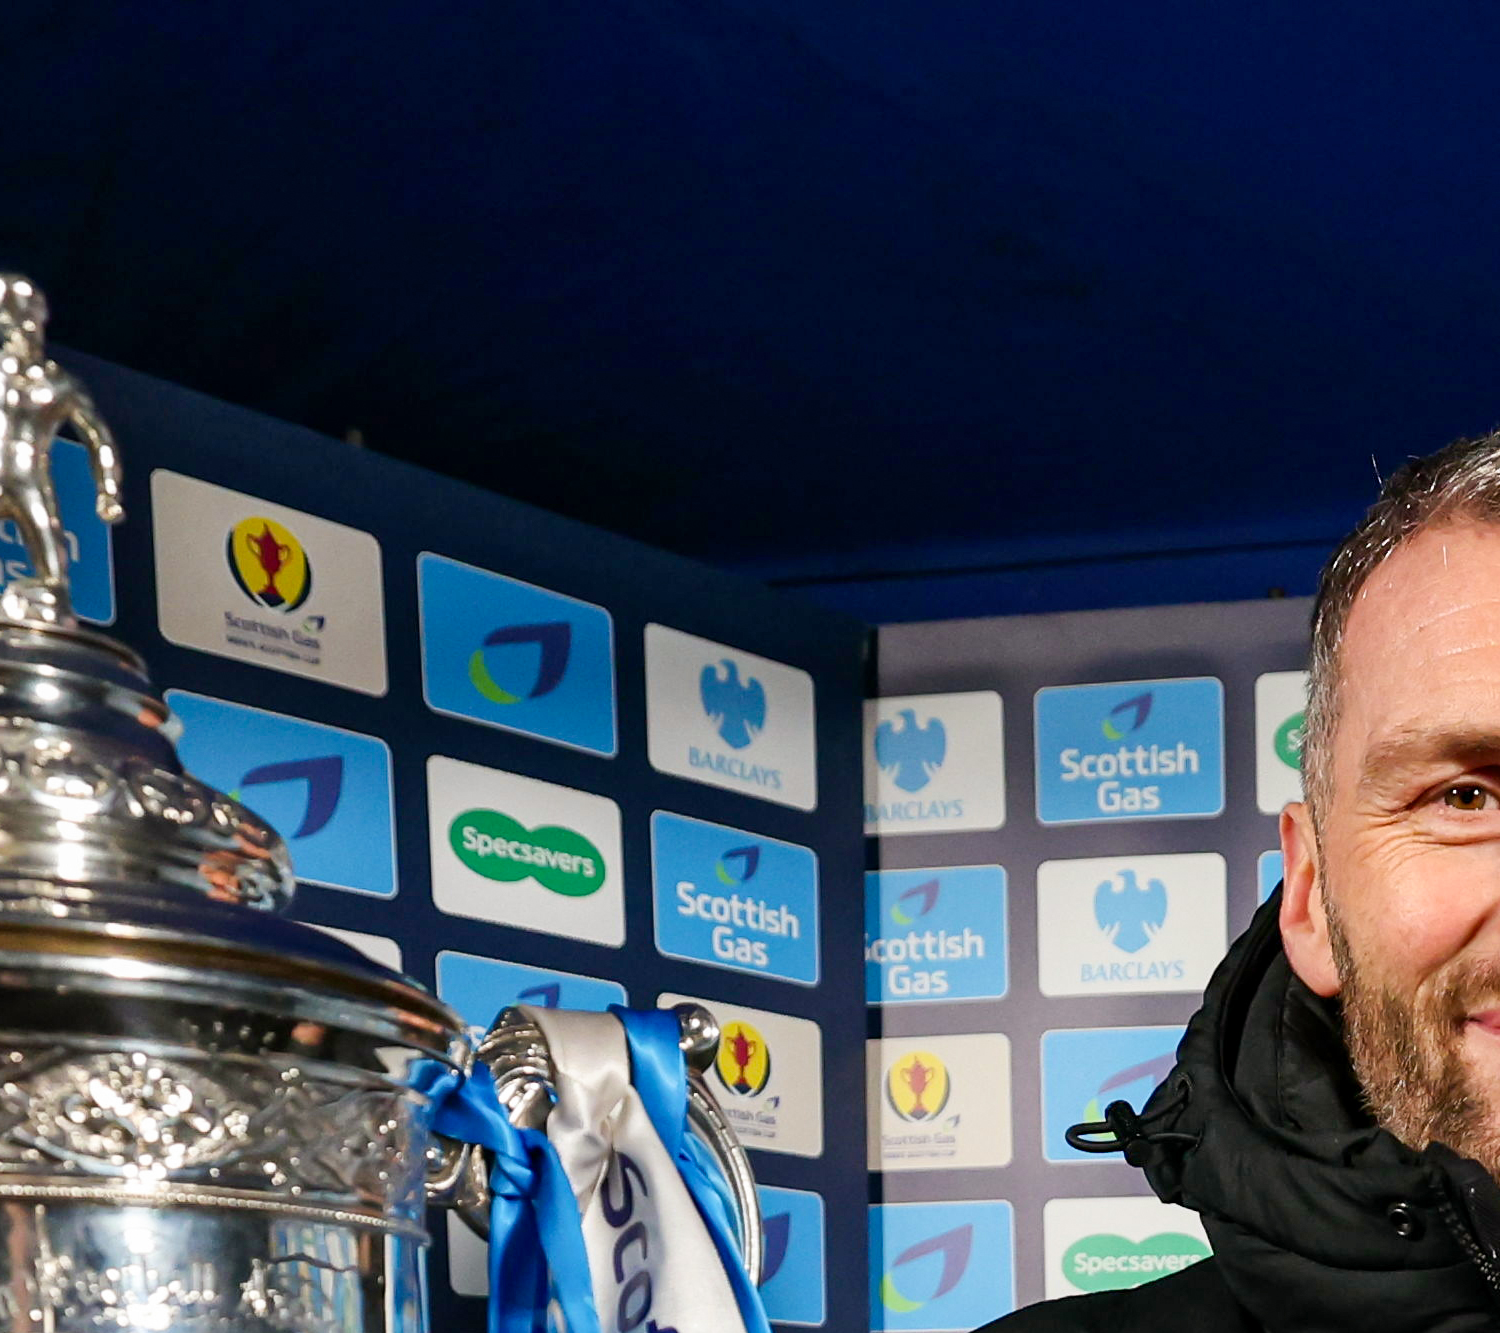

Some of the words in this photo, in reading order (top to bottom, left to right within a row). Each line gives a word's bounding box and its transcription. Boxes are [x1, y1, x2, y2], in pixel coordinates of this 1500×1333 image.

[687, 745, 781, 791] BARCLAYS
[1059, 742, 1200, 782] Scottish
[864, 799, 964, 823] BARCLAYS
[1097, 781, 1161, 813] Gas
[461, 825, 597, 877] Specsavers
[676, 882, 800, 941] Scottish
[712, 933, 769, 968] Gas
[887, 965, 949, 996] Gas
[1080, 960, 1185, 983] BARCLAYS
